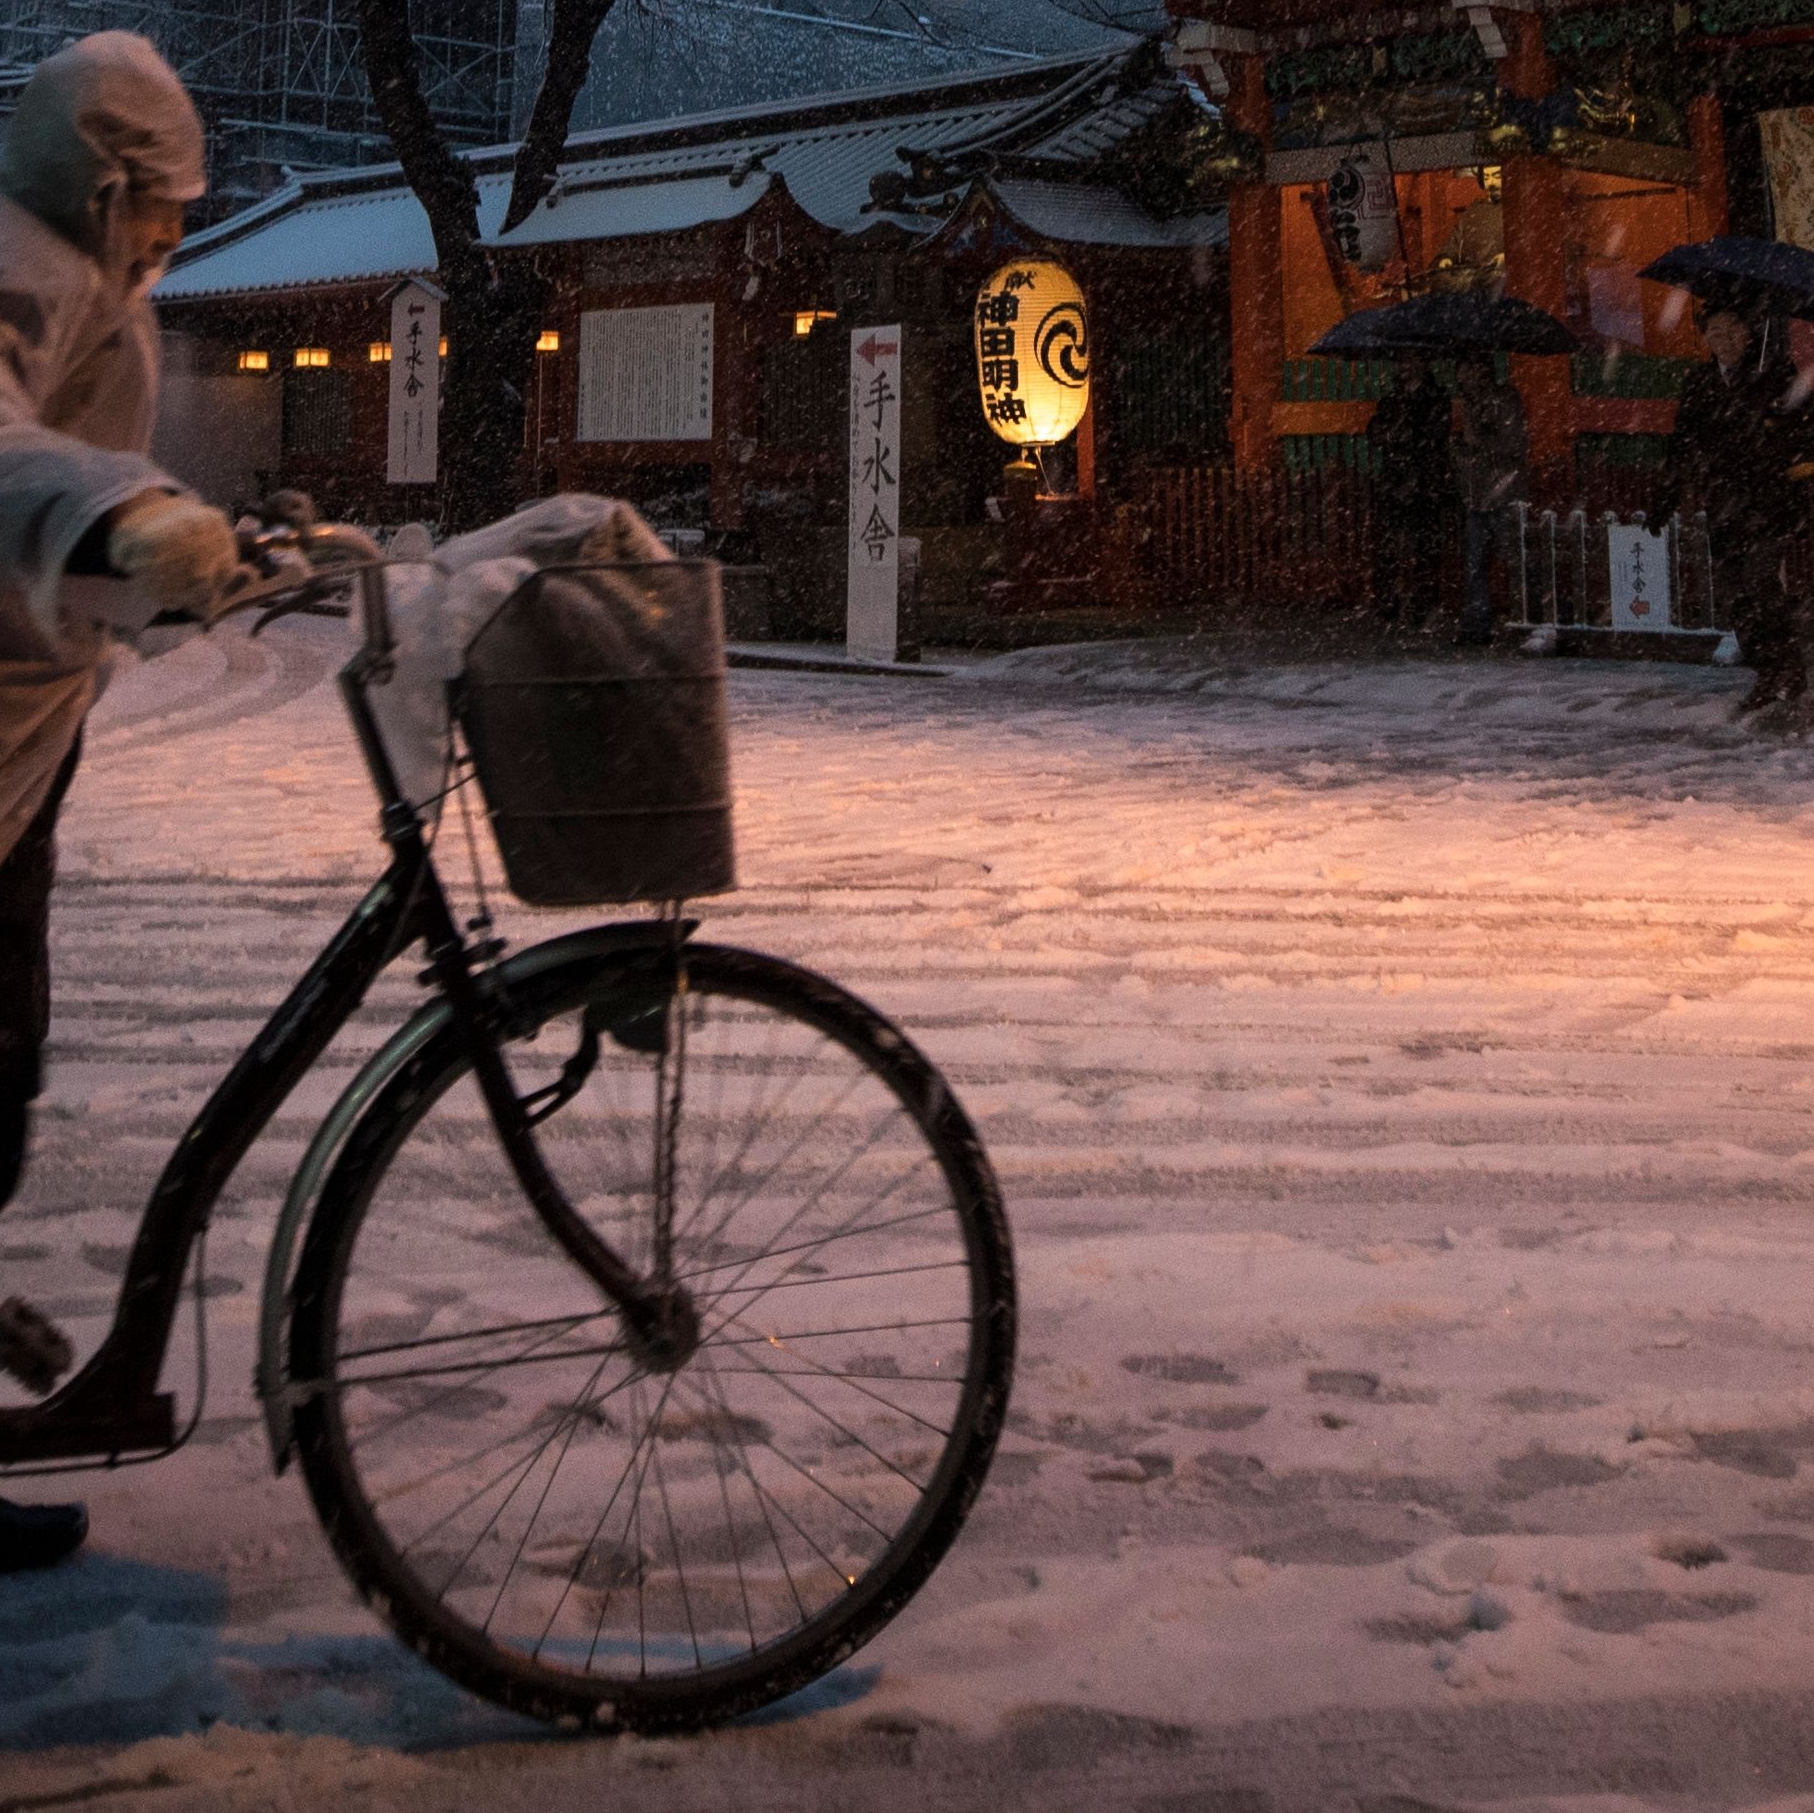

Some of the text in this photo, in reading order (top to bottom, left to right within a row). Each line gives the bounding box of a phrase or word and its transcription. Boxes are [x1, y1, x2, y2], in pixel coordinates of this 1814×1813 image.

[403, 320, 425, 398] 手水舎
[978, 290, 1027, 427] 神田明神
[859, 370, 896, 561] 手水舎
[1630, 541, 1647, 593] 手水舎
